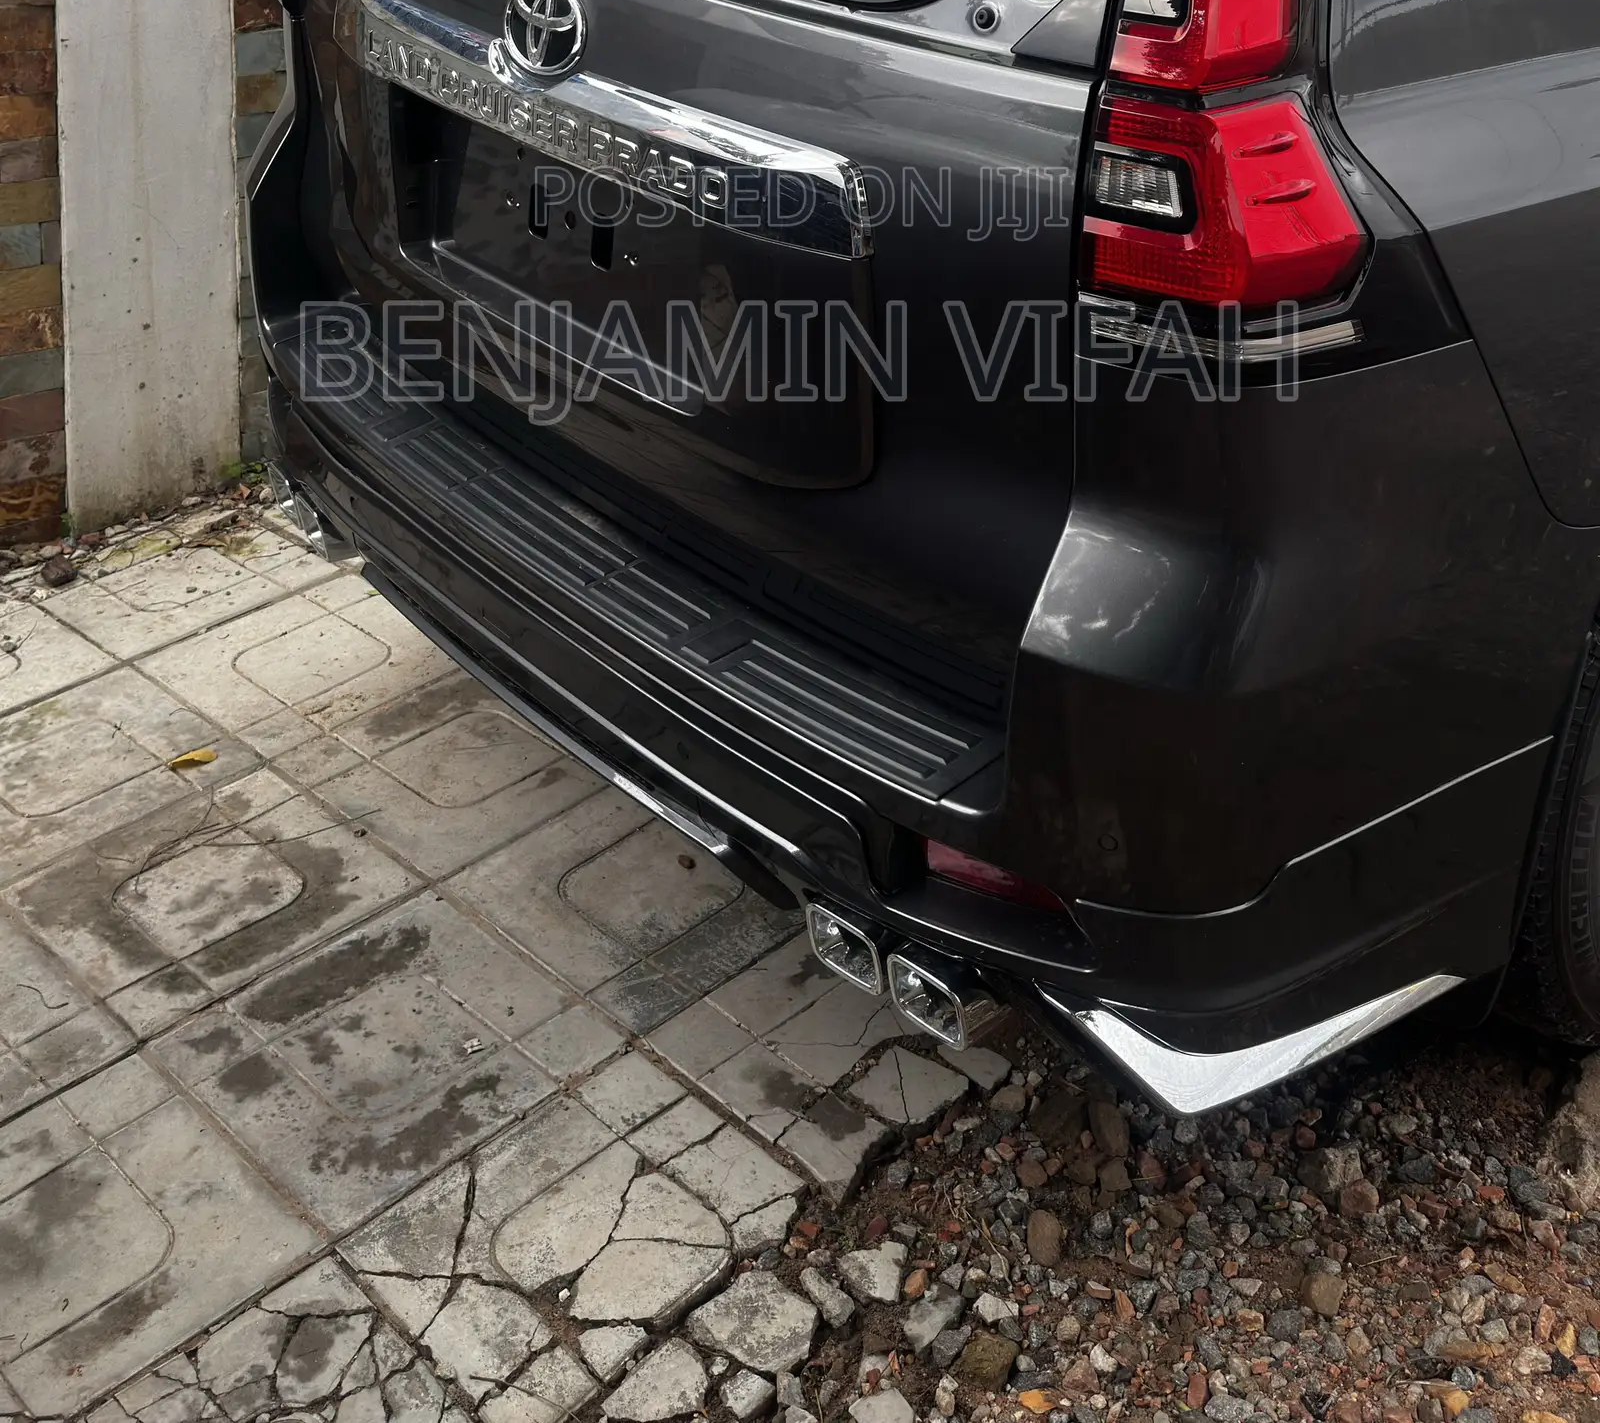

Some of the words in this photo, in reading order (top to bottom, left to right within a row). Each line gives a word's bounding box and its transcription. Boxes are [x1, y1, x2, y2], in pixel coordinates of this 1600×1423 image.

[367, 28, 433, 86] LAND
[438, 69, 579, 155] CRUISER
[586, 127, 730, 210] PRADO
